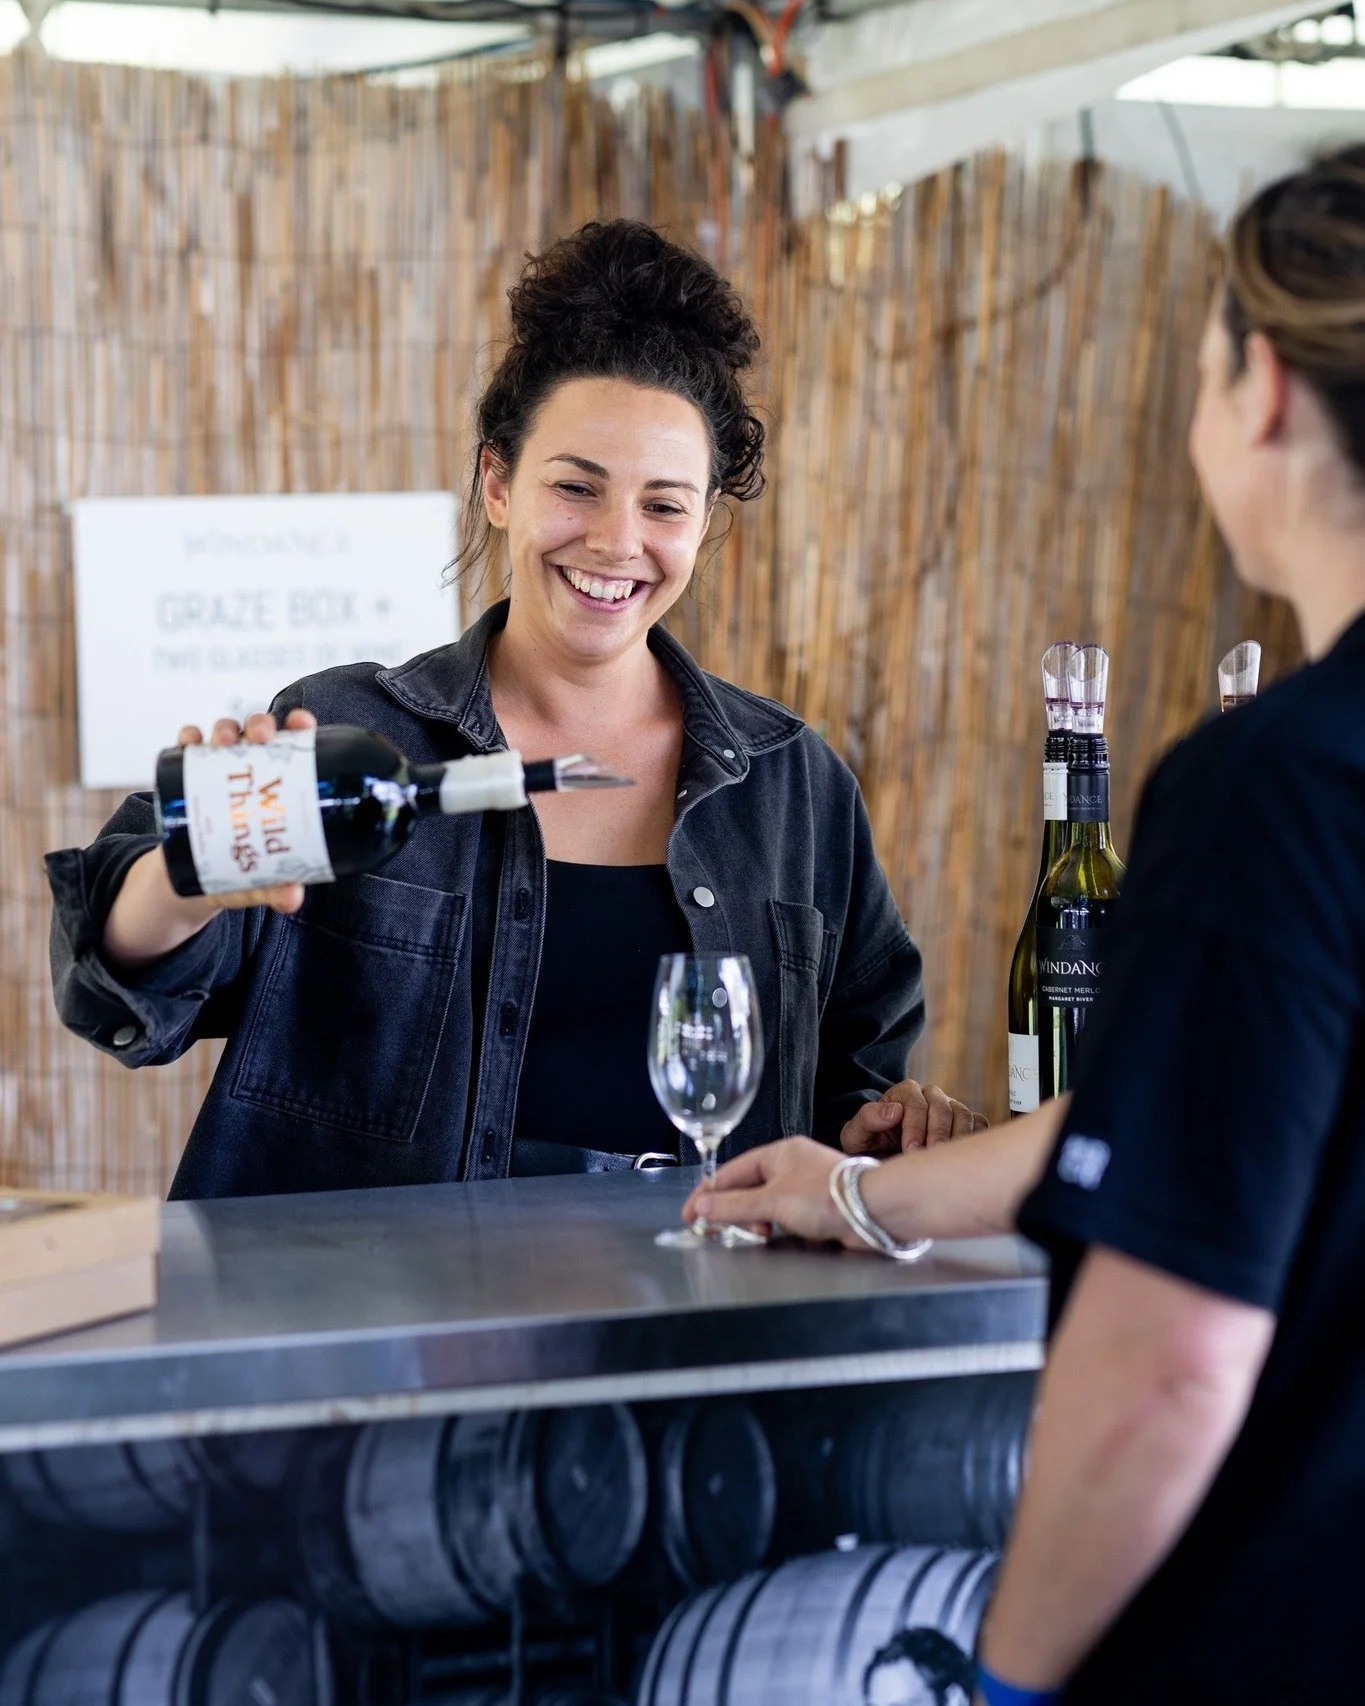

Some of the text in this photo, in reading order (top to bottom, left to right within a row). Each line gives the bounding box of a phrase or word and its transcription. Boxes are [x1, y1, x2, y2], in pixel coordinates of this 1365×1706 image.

[156, 590, 274, 631] GRAZE
[287, 588, 358, 629] BOX
[227, 764, 259, 874] Things
[259, 776, 292, 855] Wild
[1042, 985, 1073, 994] CABERNET
